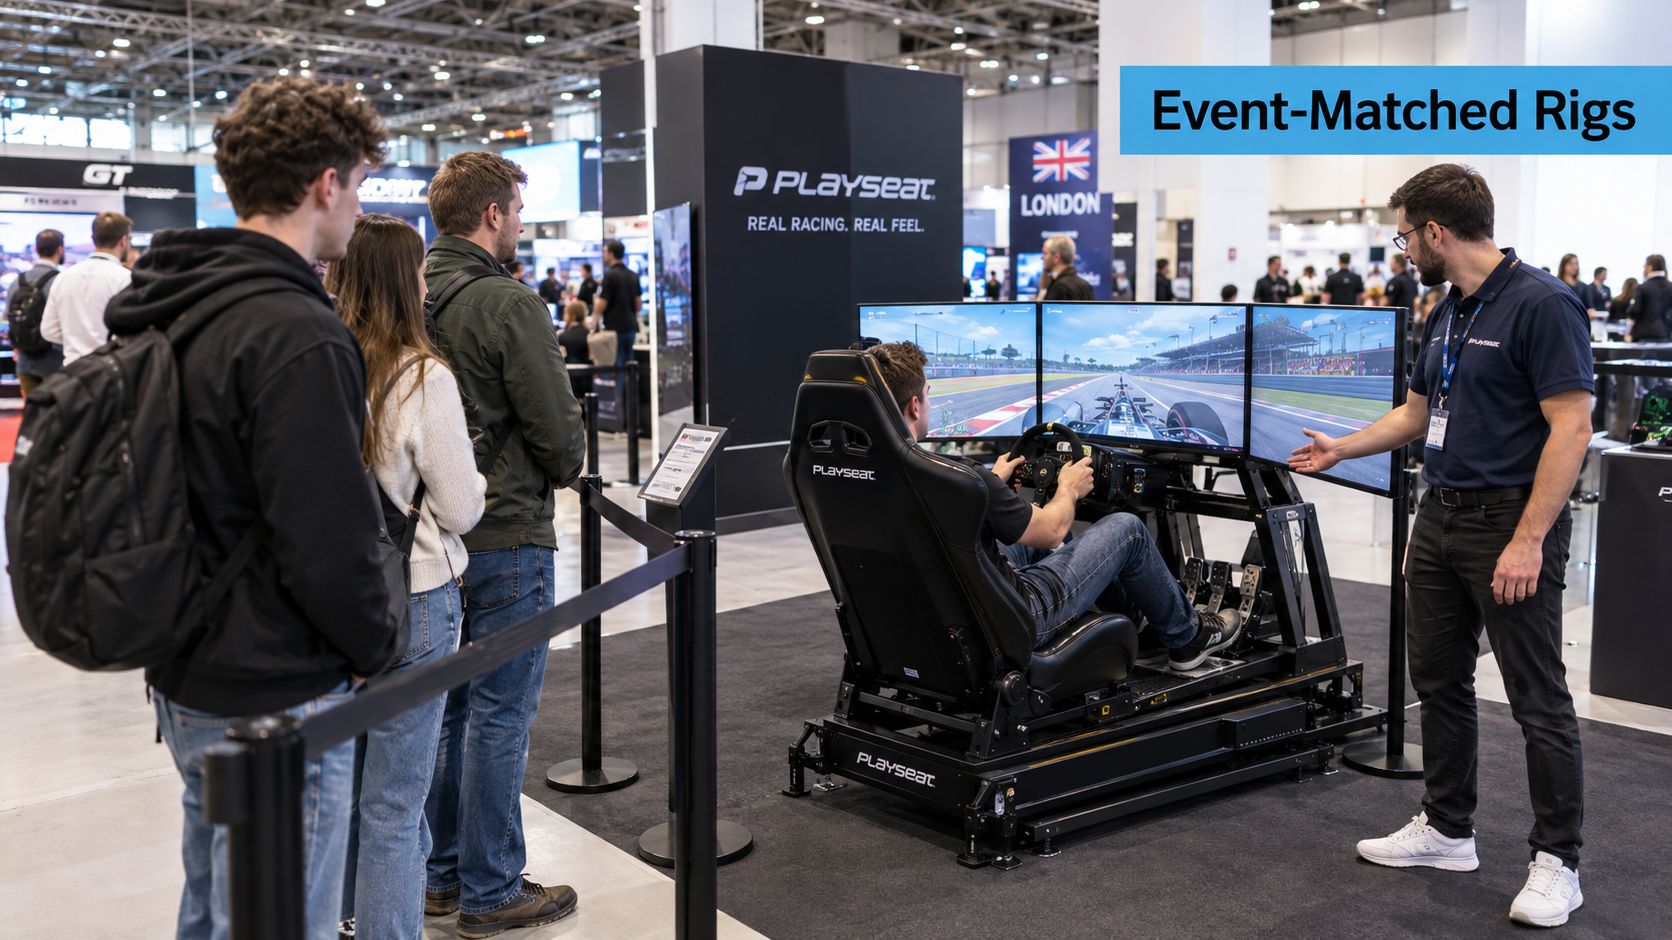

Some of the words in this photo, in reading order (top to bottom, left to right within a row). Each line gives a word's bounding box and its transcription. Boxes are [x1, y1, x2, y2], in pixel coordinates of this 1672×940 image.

[84, 164, 133, 185] GT
[773, 171, 935, 200] PLAYSEAT
[1022, 192, 1100, 216] LONDON
[748, 217, 786, 231] REAL
[792, 217, 848, 231] RACING.
[854, 218, 887, 231] REAL
[892, 219, 924, 232] FEEL.
[813, 465, 874, 480] PLAYSEAT
[857, 752, 935, 787] PLAYSEAT
